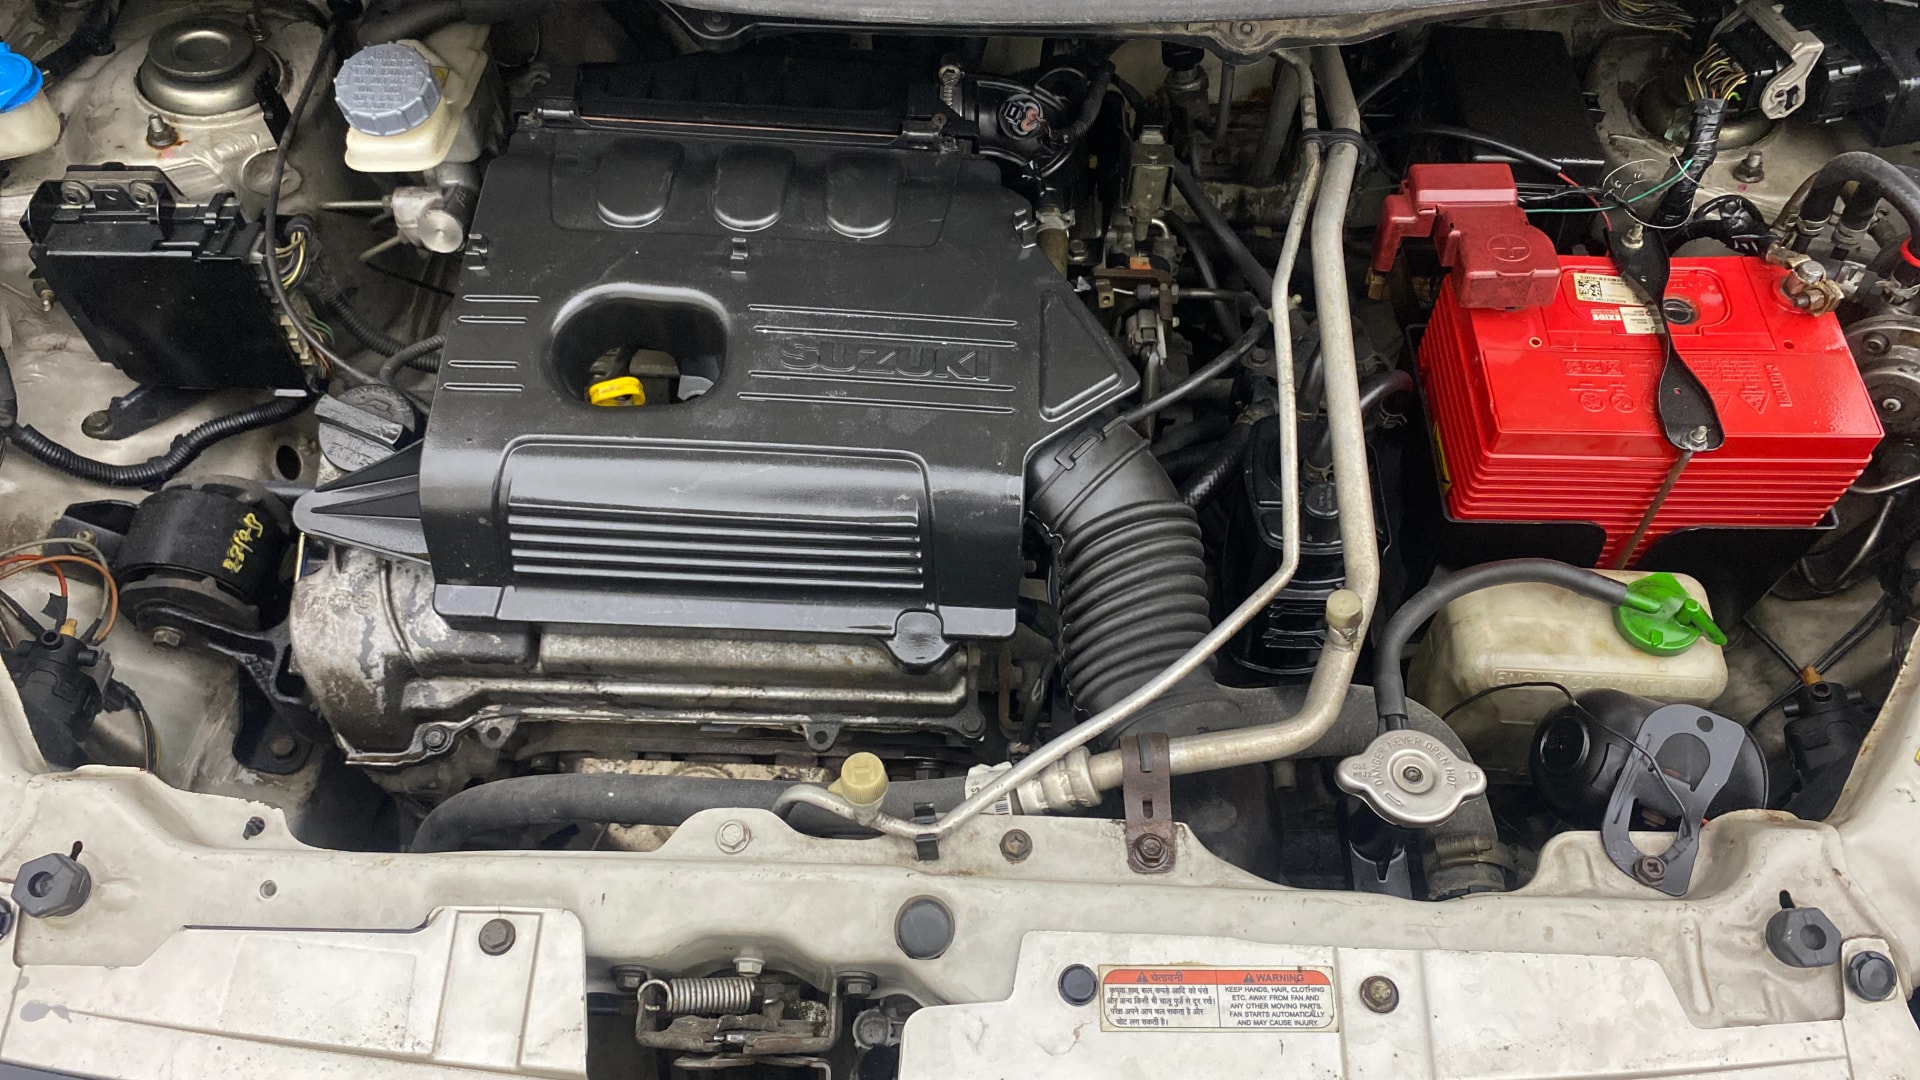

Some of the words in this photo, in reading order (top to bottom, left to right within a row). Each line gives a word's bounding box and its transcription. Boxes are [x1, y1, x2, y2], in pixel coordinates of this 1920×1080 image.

[780, 341, 991, 382] SUZUKI
[1372, 746, 1388, 787] DANGER
[1387, 736, 1422, 749] NEVER
[1425, 742, 1451, 766] OPEN
[1444, 767, 1457, 789] HOT
[1150, 970, 1184, 983] चेतावनी
[1256, 973, 1304, 983] WARNING
[1172, 986, 1186, 994] आदि
[1188, 986, 1196, 994] को
[1134, 996, 1149, 1004] किसी
[1151, 996, 1157, 1004] भी
[1125, 1006, 1139, 1014] अपने
